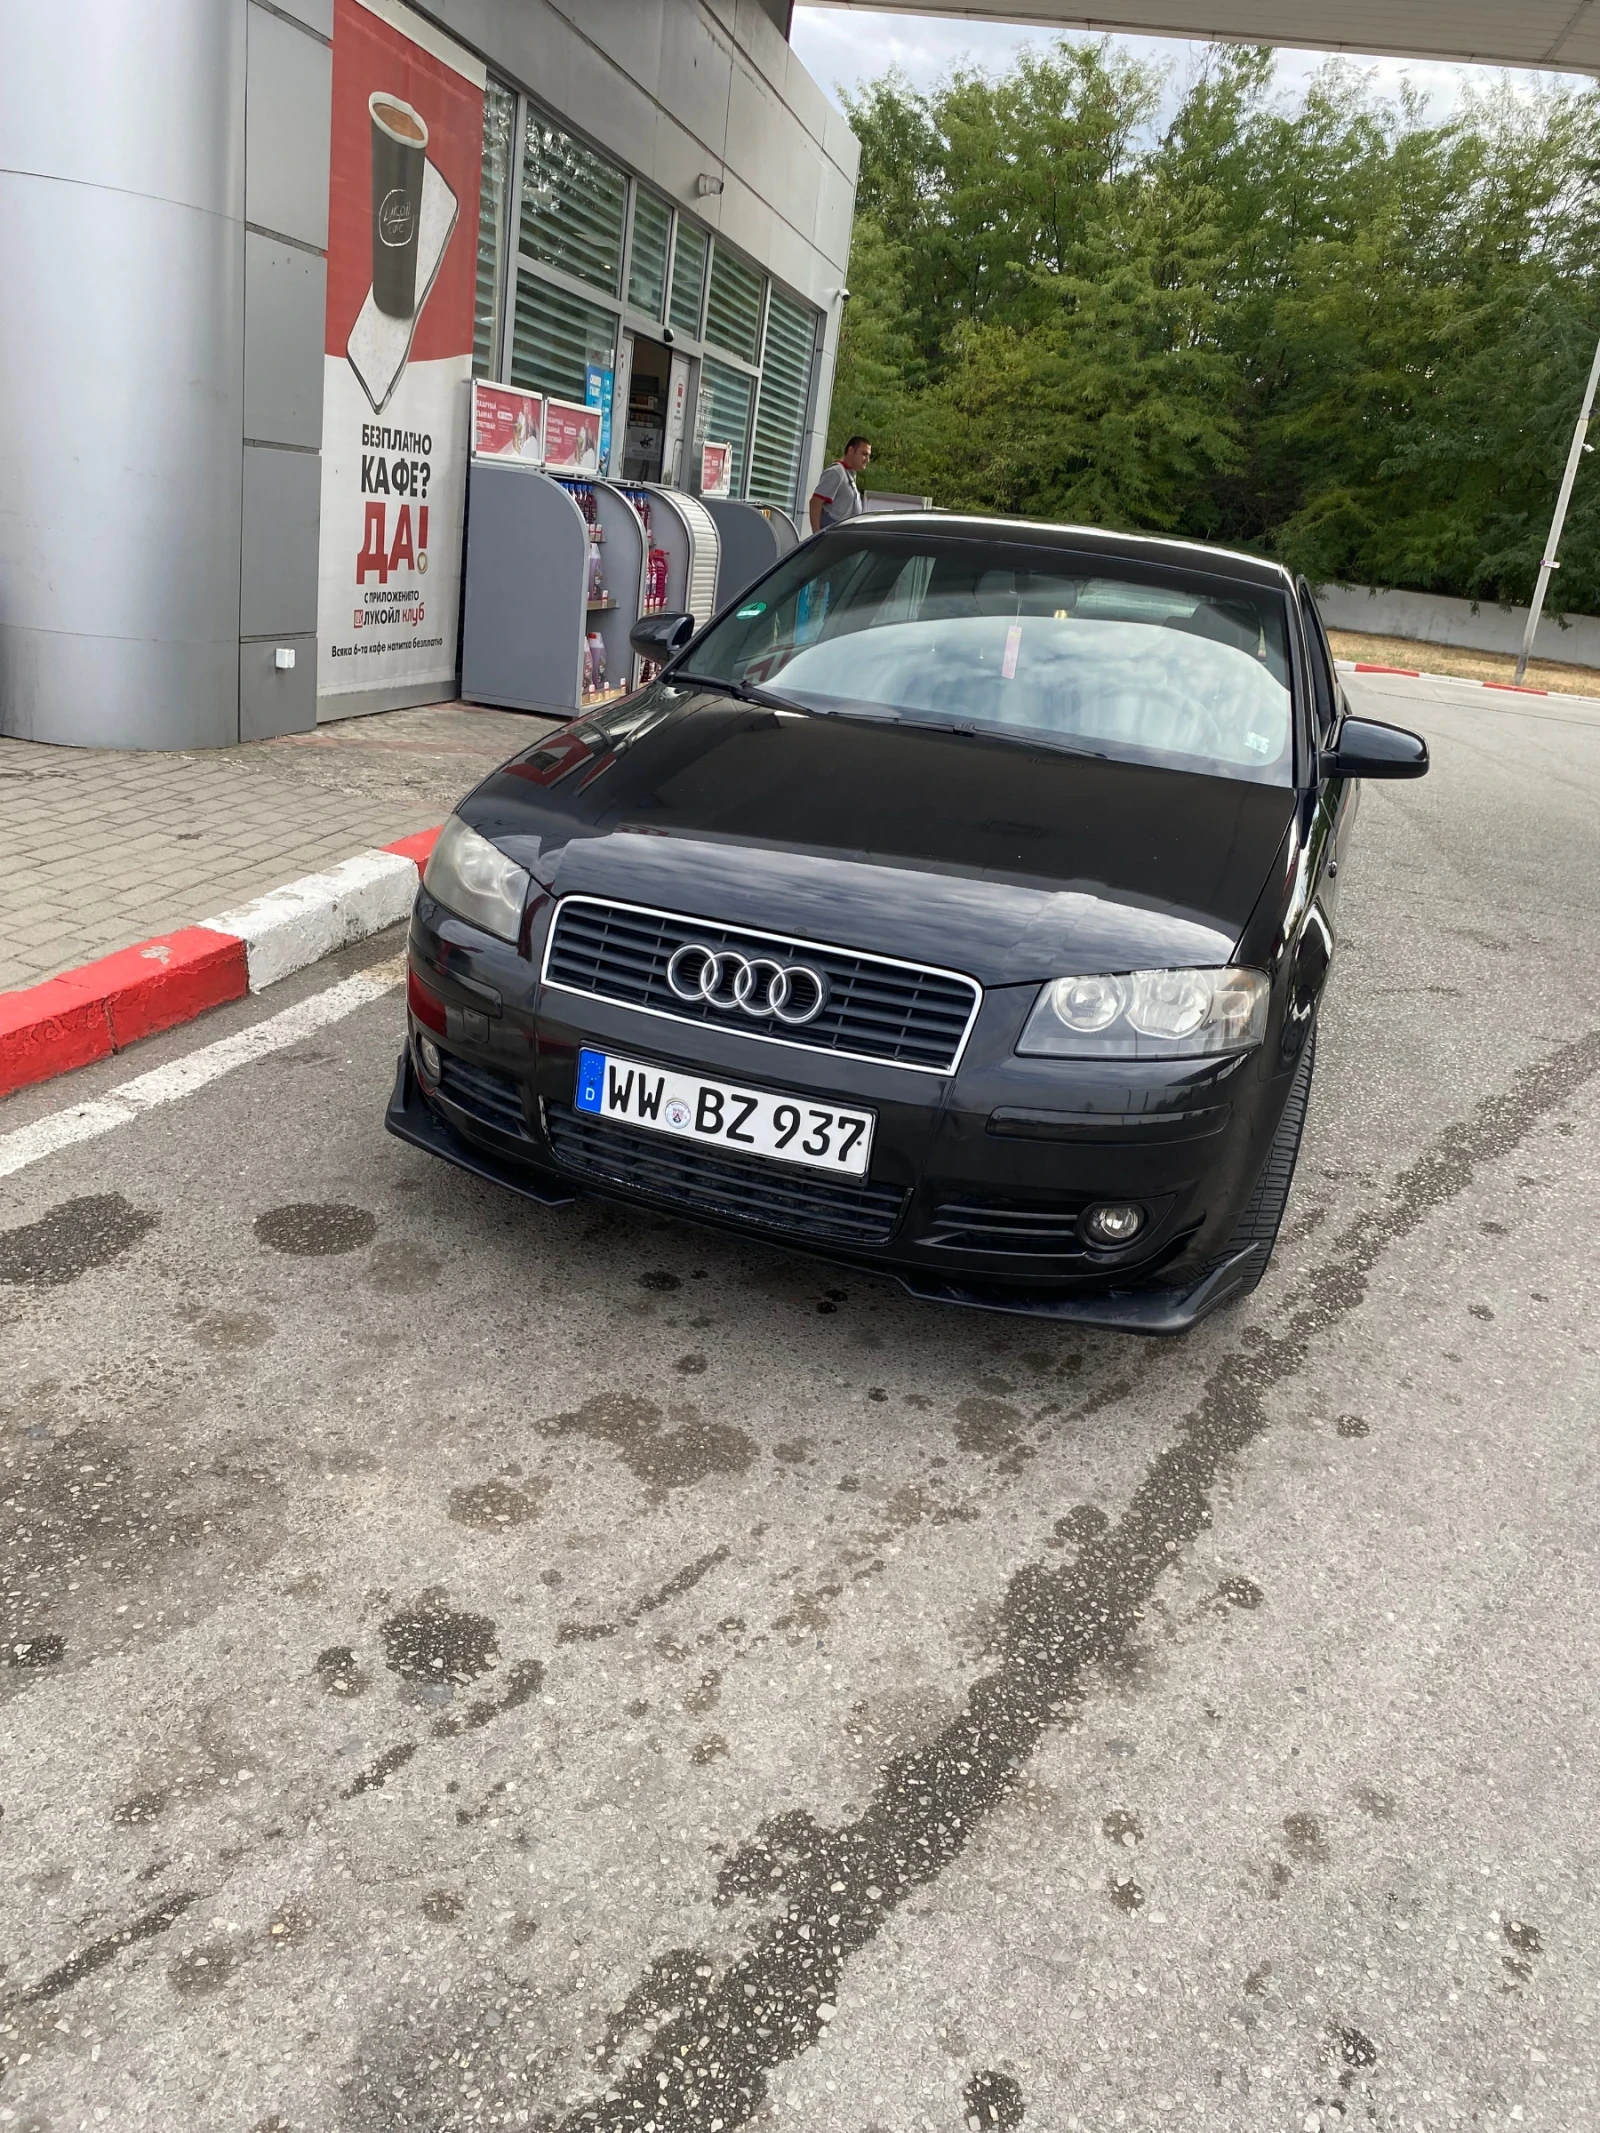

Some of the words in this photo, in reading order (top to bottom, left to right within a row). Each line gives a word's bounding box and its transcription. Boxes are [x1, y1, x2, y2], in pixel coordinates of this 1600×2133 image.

[362, 423, 432, 456] БЕЗПЛАТНО
[361, 454, 431, 499] КАФЕ?
[356, 501, 429, 585] ДА!
[363, 606, 400, 626] ЛУКОЙЛ
[402, 602, 425, 627] клуб
[331, 645, 353, 658] Всяка
[369, 641, 386, 656] кафе
[387, 639, 411, 652] напитка
[412, 637, 443, 649] безплатно
[585, 1086, 595, 1101] D
[609, 1065, 665, 1121] WW
[695, 1086, 759, 1144] BZ
[773, 1104, 866, 1162] 937
